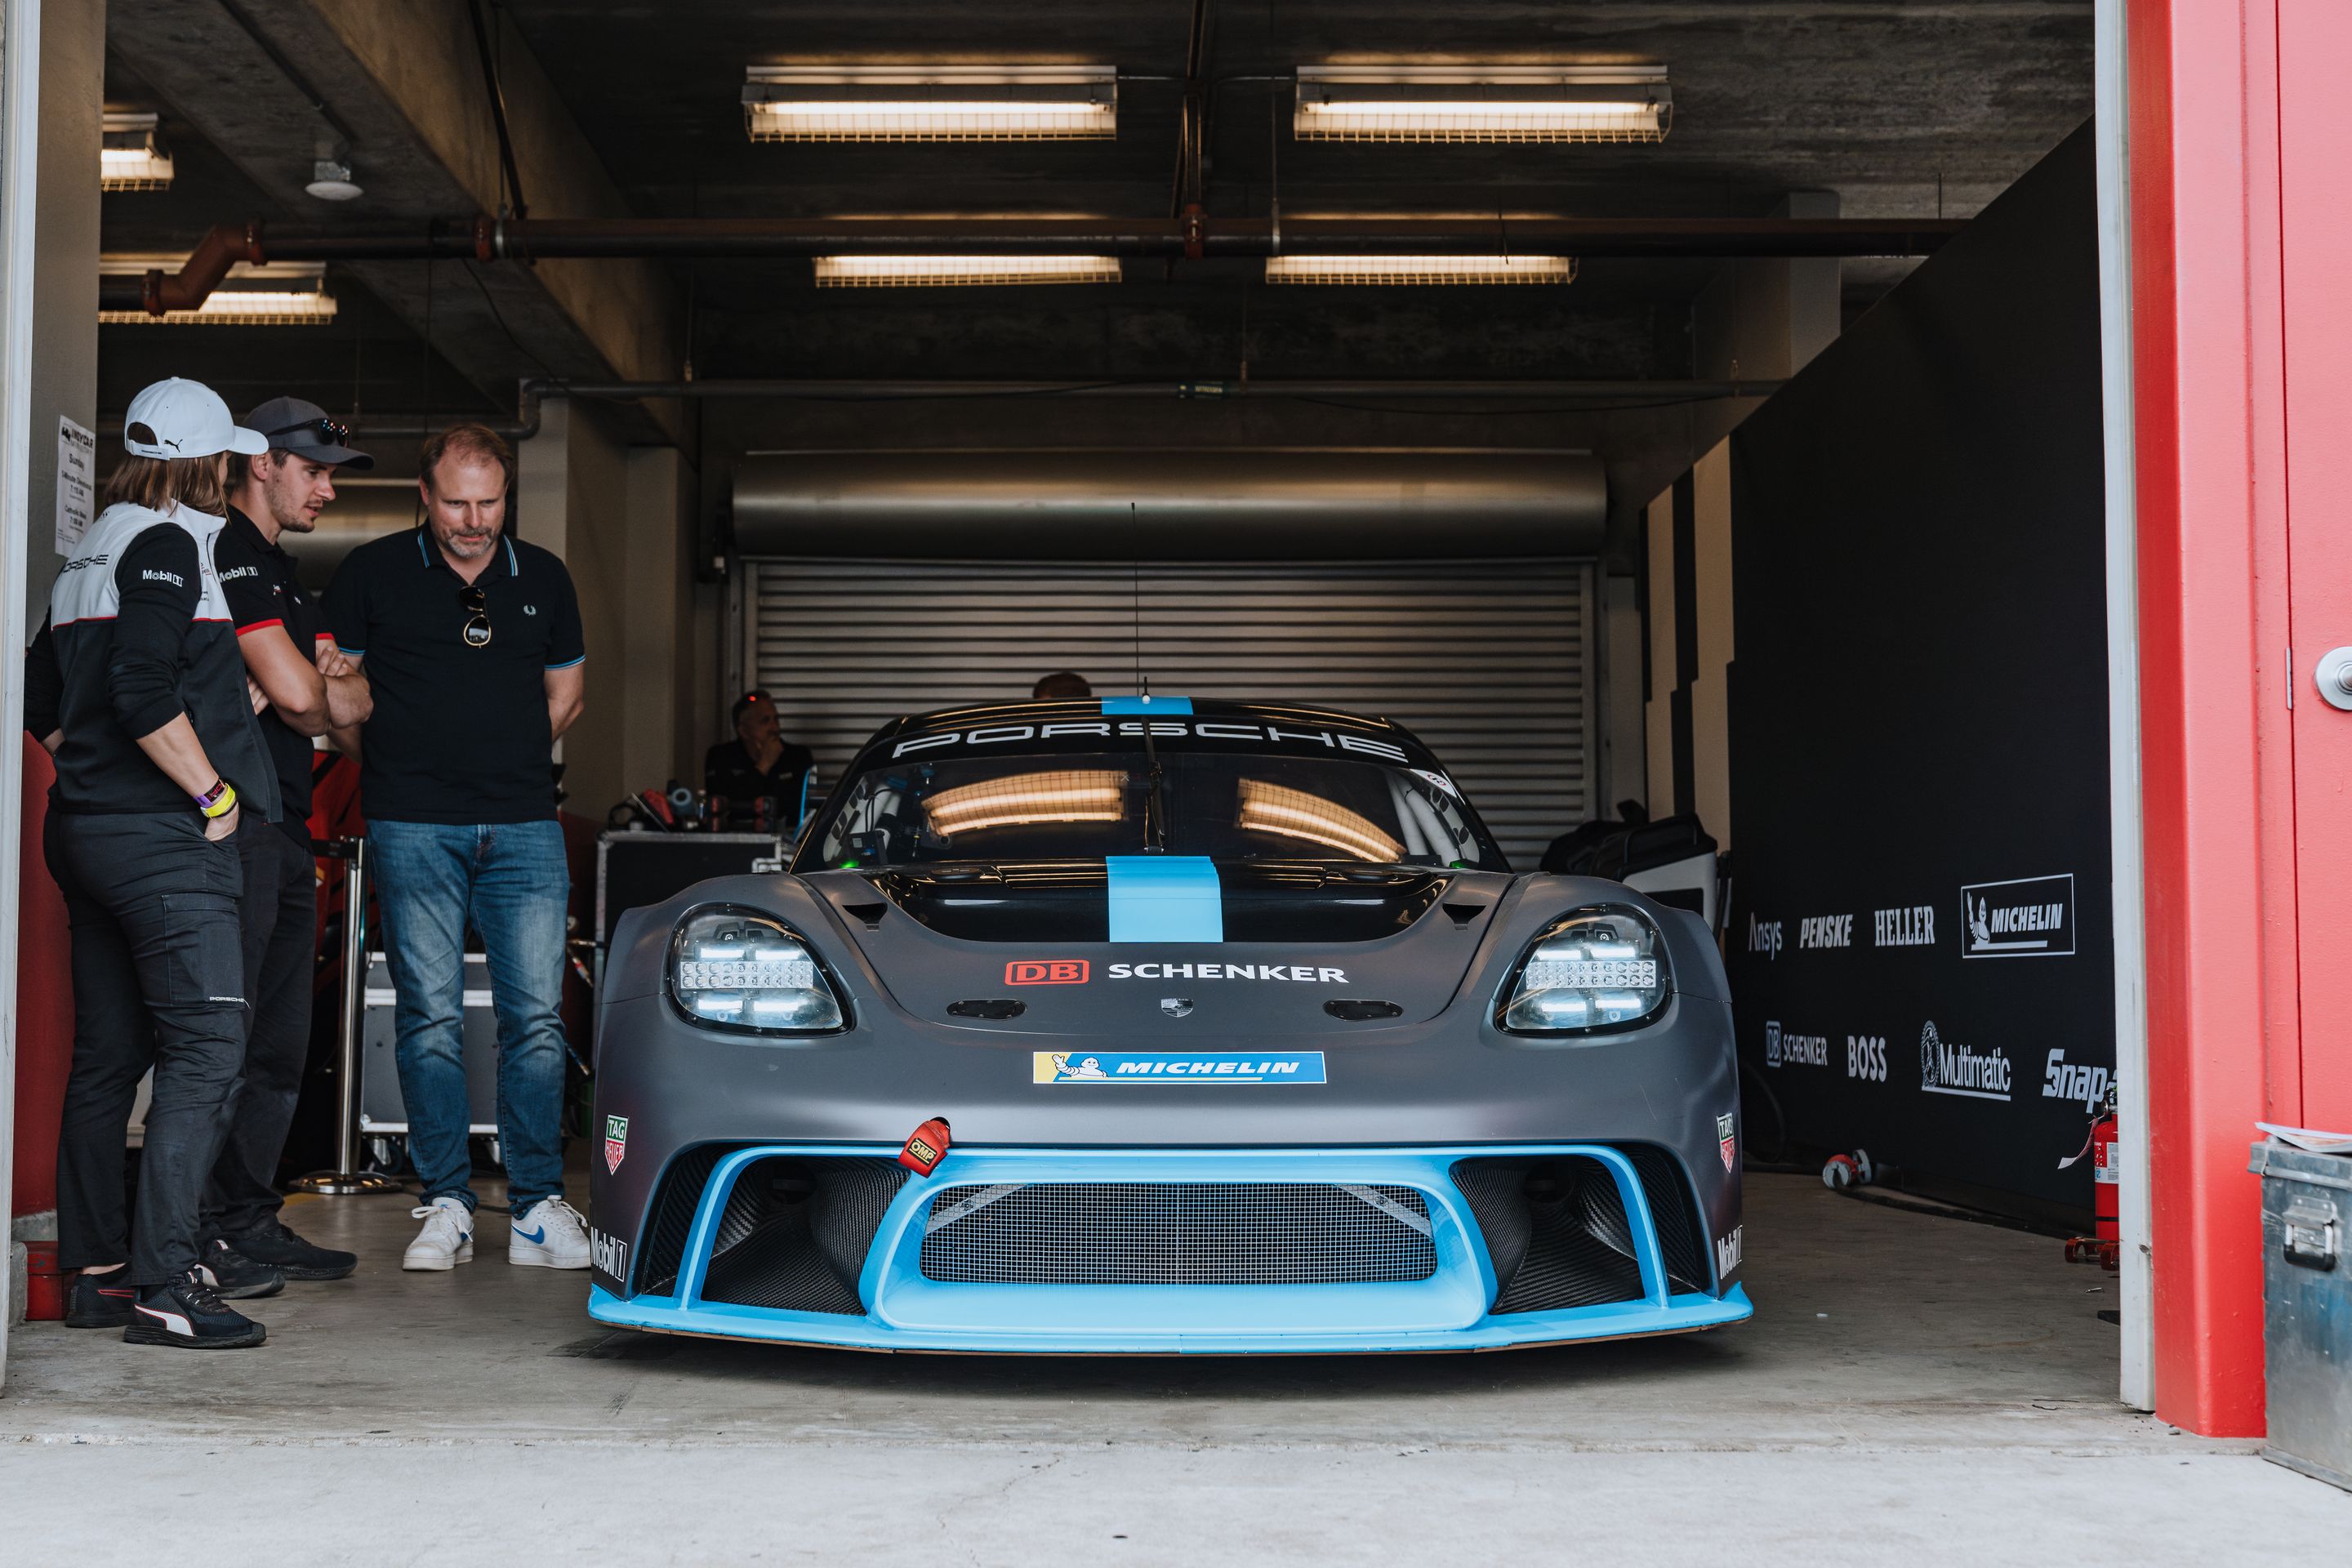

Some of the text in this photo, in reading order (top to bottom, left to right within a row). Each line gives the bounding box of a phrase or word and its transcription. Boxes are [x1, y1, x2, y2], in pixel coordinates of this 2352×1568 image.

[143, 569, 172, 582] Mobil
[893, 722, 1409, 764] PORSCHE
[1748, 903, 2063, 960] Ansys PENSKE HELLER MICHELIN
[1013, 962, 1349, 983] DB SCHENKER
[1116, 1061, 1300, 1075] MICHELIN
[1767, 1027, 1780, 1061] DB
[1784, 1034, 1828, 1066] SCHENKER
[1847, 1035, 1887, 1082] BOSS
[1940, 1044, 2011, 1093] Multimatic
[608, 1119, 626, 1139] TAG
[1719, 1117, 1733, 1138] TAG
[605, 1142, 623, 1169] HEUER
[911, 1142, 934, 1160] OMP
[591, 1227, 616, 1276] Mobil
[1717, 1229, 1737, 1280] Mobil
